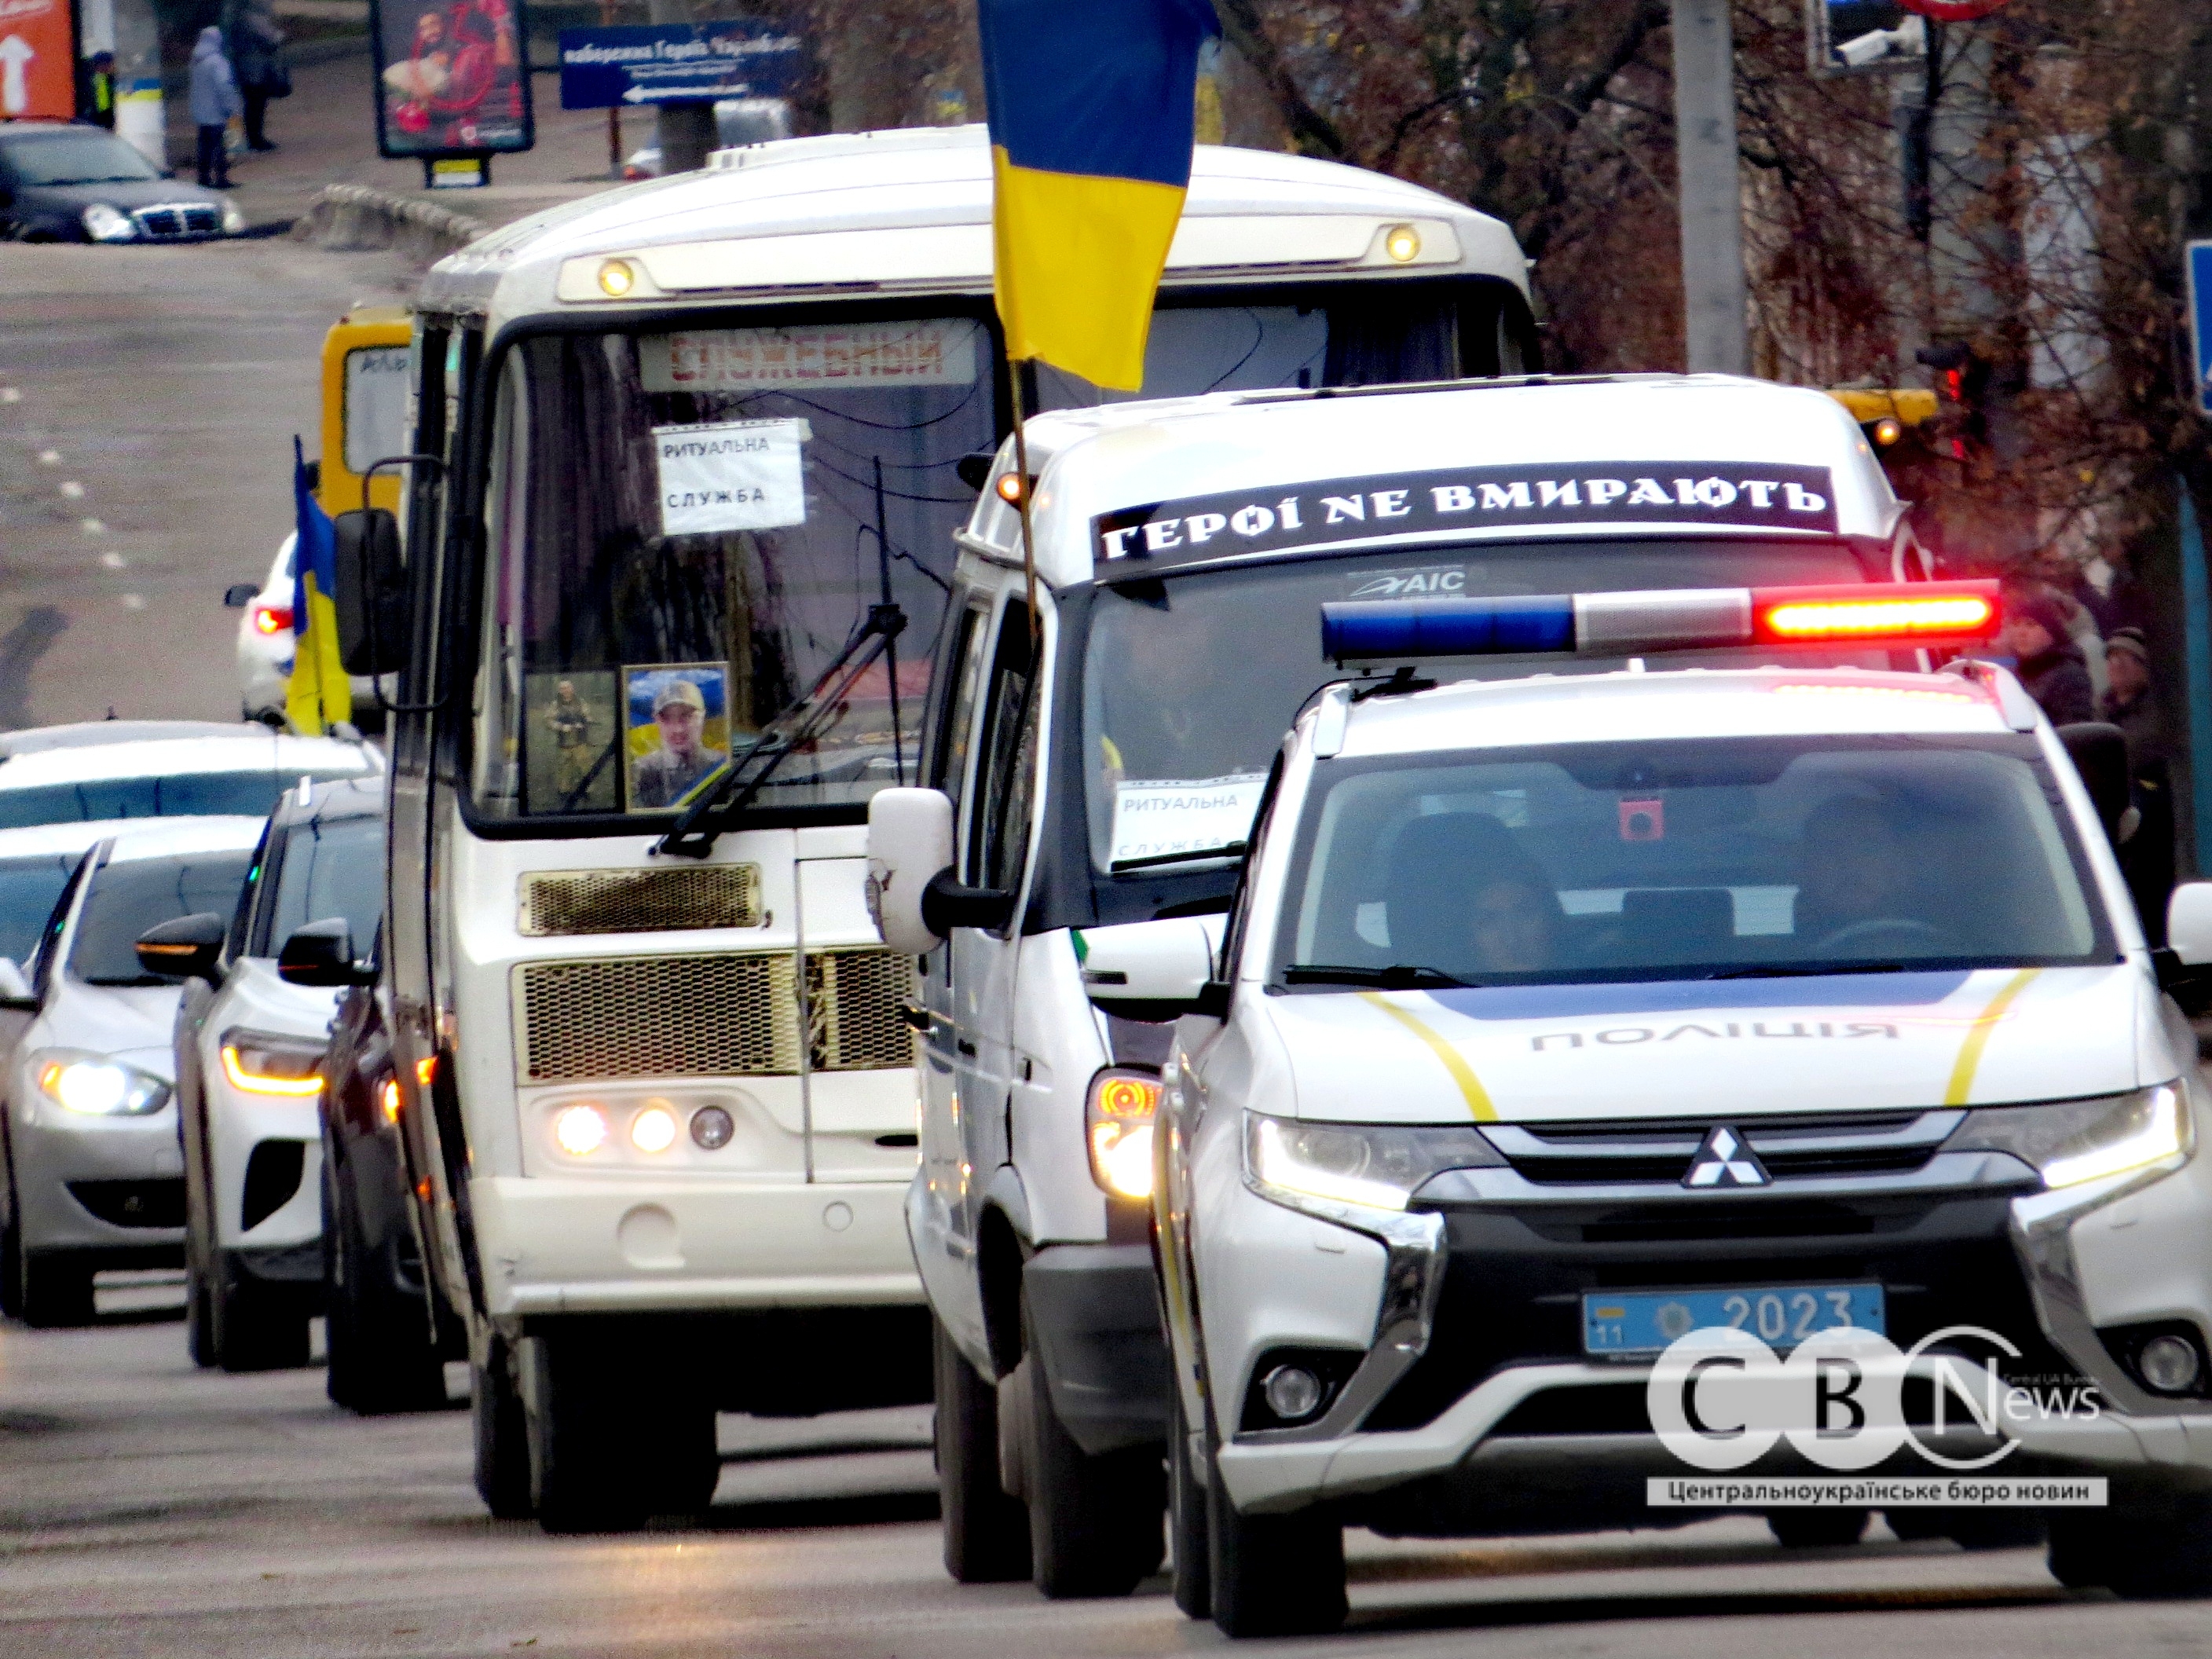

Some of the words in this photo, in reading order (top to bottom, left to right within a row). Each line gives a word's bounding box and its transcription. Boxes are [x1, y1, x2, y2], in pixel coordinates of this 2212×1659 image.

[664, 438, 770, 458] РИТУАЛЬНА
[668, 489, 765, 508] СЛУЖБА
[1101, 496, 1305, 560] ГЕРОЇ
[1428, 474, 1829, 515] ВМИРАЮТЬ
[1402, 571, 1466, 592] AIC
[1123, 794, 1239, 812] РИТУАЛЬНА
[1118, 837, 1222, 857] СЛУЖБА
[1530, 1021, 1900, 1051] ПОЛІЦІЯ
[1723, 1291, 1854, 1342] 2023
[1597, 1324, 1624, 1345] 11
